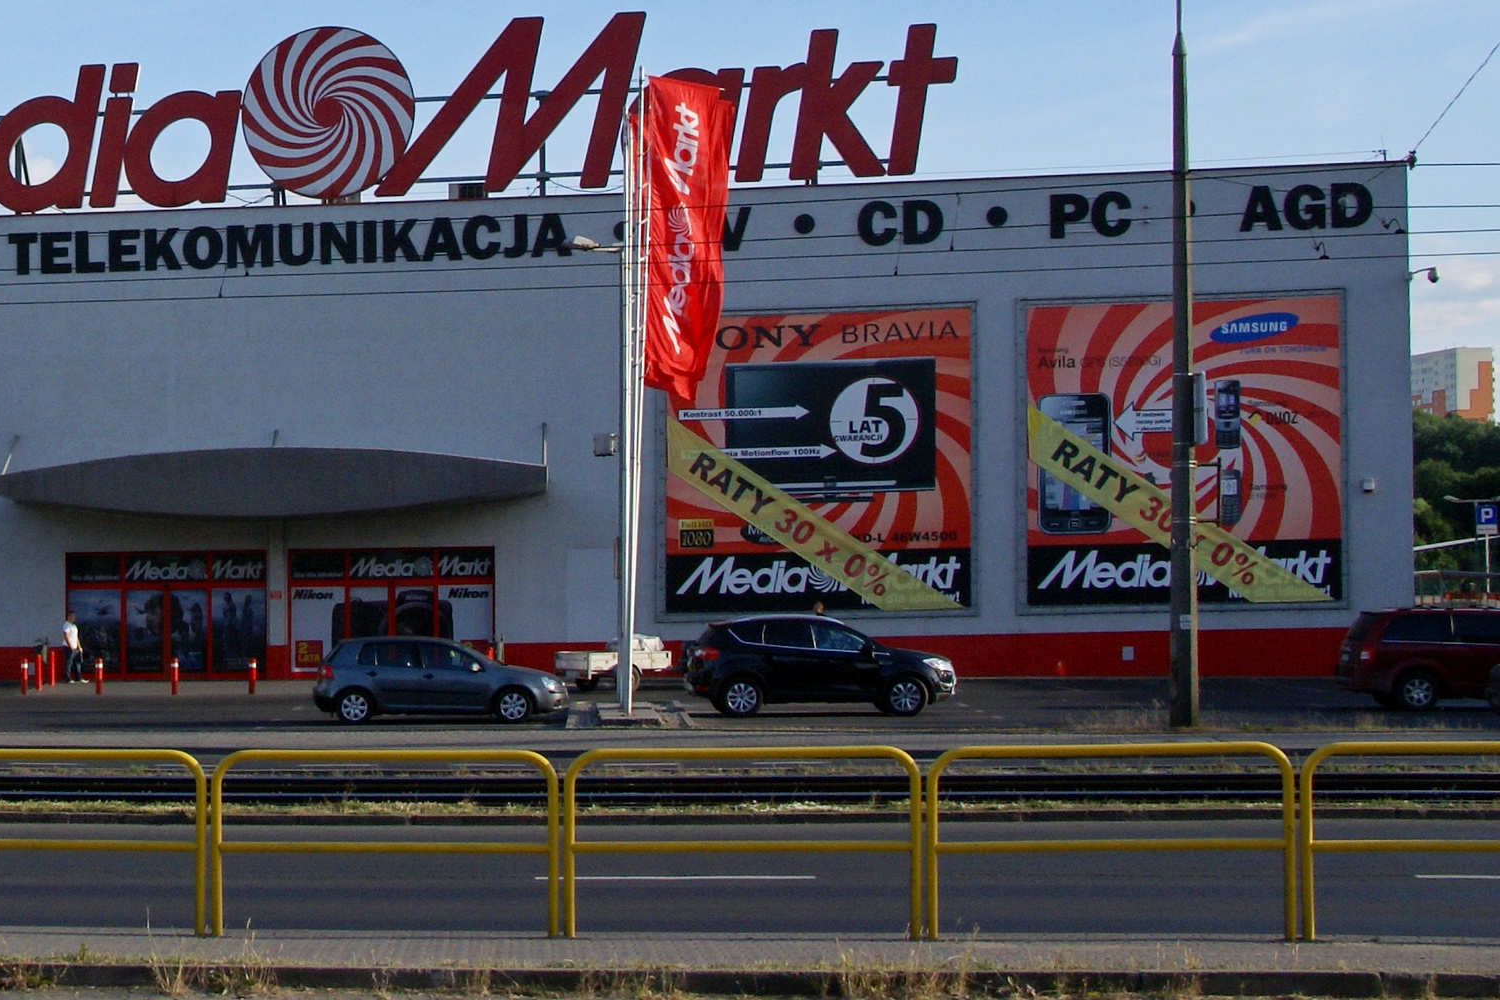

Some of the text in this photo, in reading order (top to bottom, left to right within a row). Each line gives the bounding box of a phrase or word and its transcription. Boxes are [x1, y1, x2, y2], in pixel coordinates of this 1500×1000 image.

[664, 102, 700, 195] Markt
[8, 213, 573, 275] TELEKOMUNIKACJA
[723, 207, 751, 251] V
[857, 200, 944, 246] CD
[1049, 190, 1132, 239] PC
[1239, 182, 1374, 232] AGD
[1221, 321, 1288, 334] SAMSUNG
[715, 321, 959, 350] ONY BRAVIA
[1038, 356, 1075, 369] Avila
[683, 409, 722, 419] Kontrast
[860, 383, 906, 458] 5
[848, 420, 883, 434] LAT
[834, 433, 883, 443] GWARANCJI
[741, 448, 790, 458] Motionflow
[1051, 438, 1140, 502] RATY
[1211, 543, 1257, 585] 0%
[1481, 508, 1493, 523] P
[689, 452, 891, 597] RATY 30 x 0%
[681, 531, 712, 546] 1080
[125, 559, 264, 580] Media Markt
[350, 556, 491, 577] Media Markt
[676, 553, 961, 595] Media arkt
[1038, 546, 1331, 589] Media arkt
[293, 589, 334, 600] Nikon
[448, 588, 489, 599] Nikon
[298, 642, 308, 654] 2
